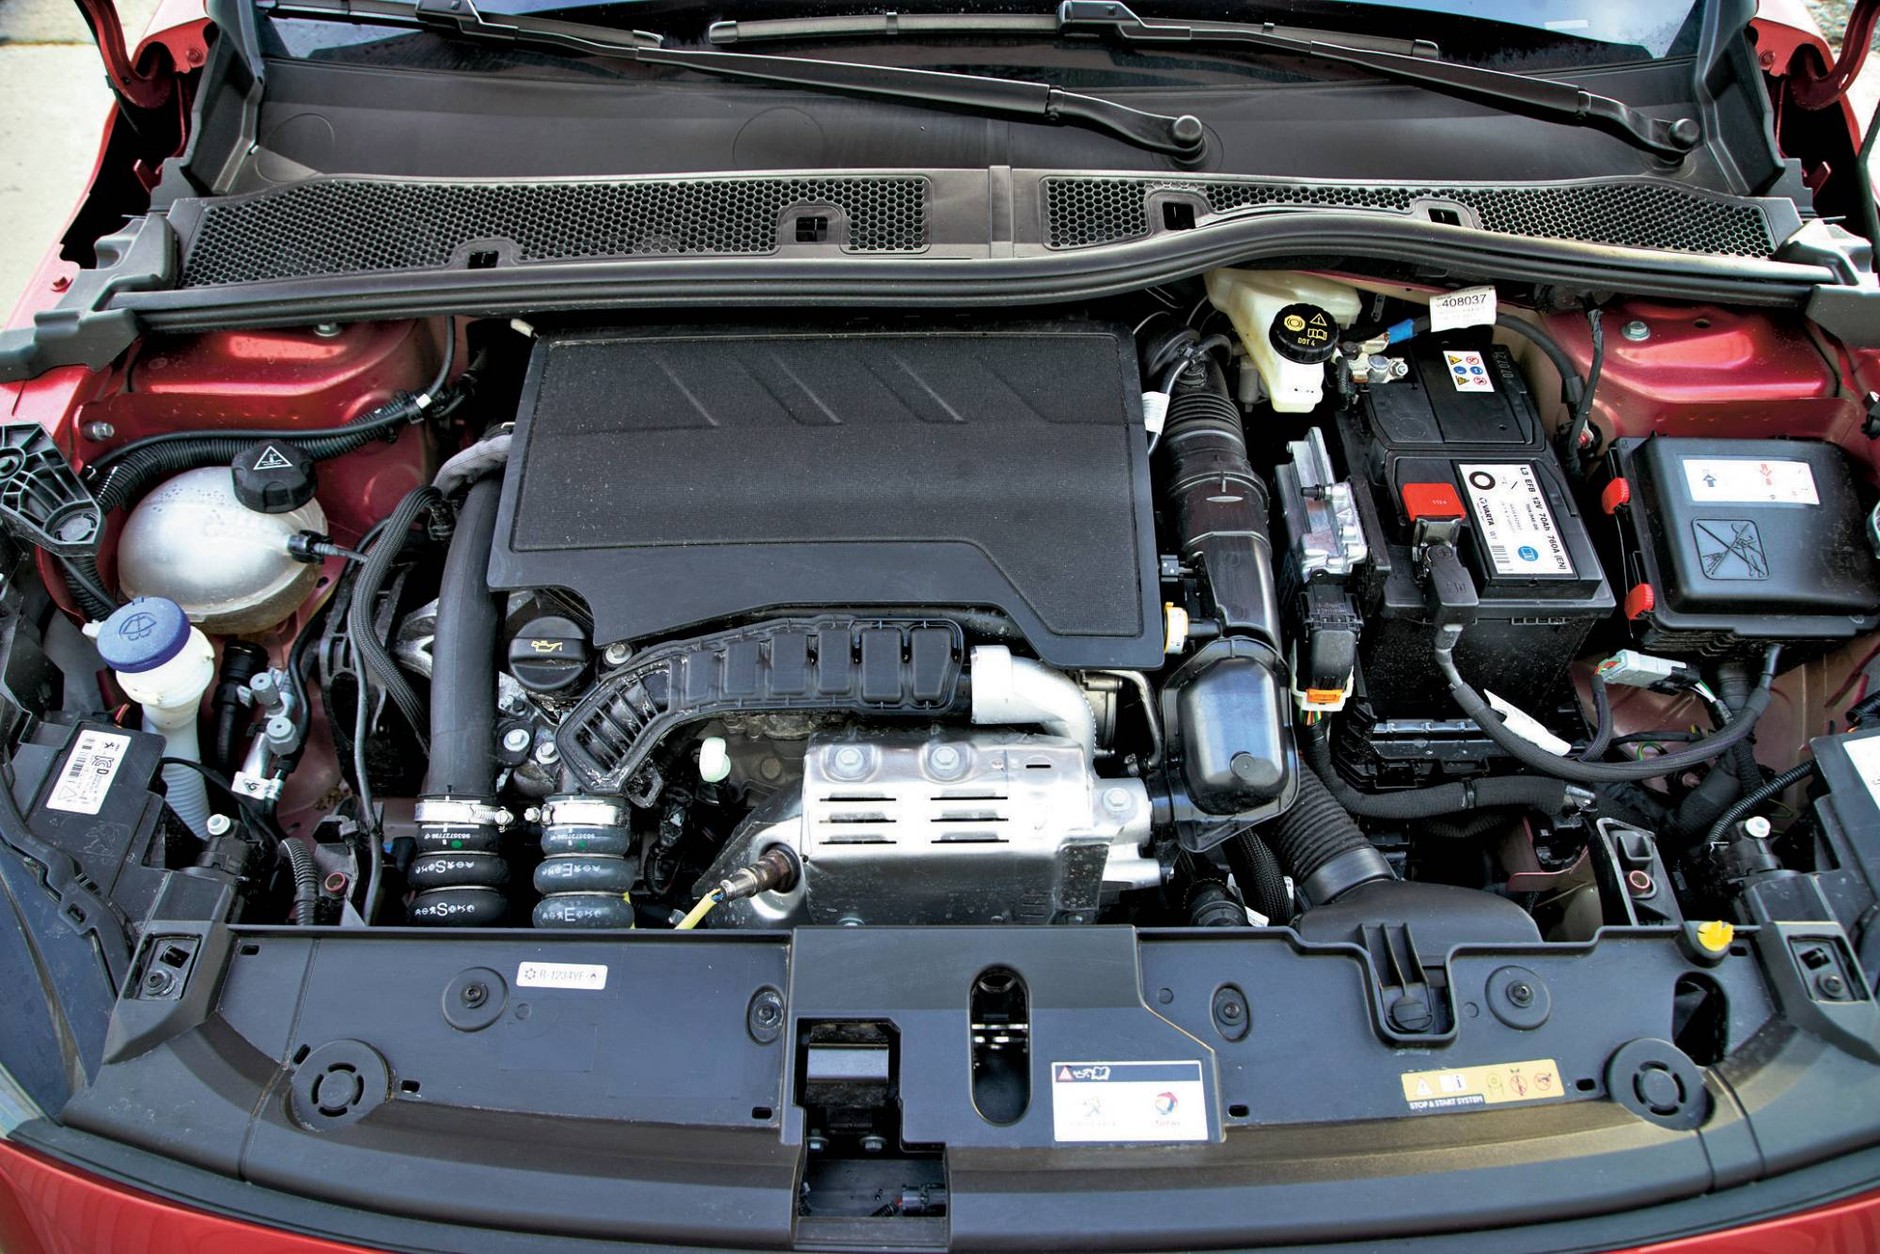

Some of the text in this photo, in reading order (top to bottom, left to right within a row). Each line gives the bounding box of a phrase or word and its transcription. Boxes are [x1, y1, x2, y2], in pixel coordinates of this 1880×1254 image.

[1442, 294, 1487, 307] 408037
[1482, 503, 1495, 527] VARTA
[1520, 467, 1530, 476] L3
[1525, 478, 1536, 492] EFB
[1532, 496, 1544, 510] 12V
[1539, 512, 1551, 532] 70Ah
[1547, 535, 1560, 554] 760A
[1410, 1101, 1428, 1110] STOP
[1435, 1098, 1456, 1106] START
[1456, 1095, 1483, 1104] SYSTEM
